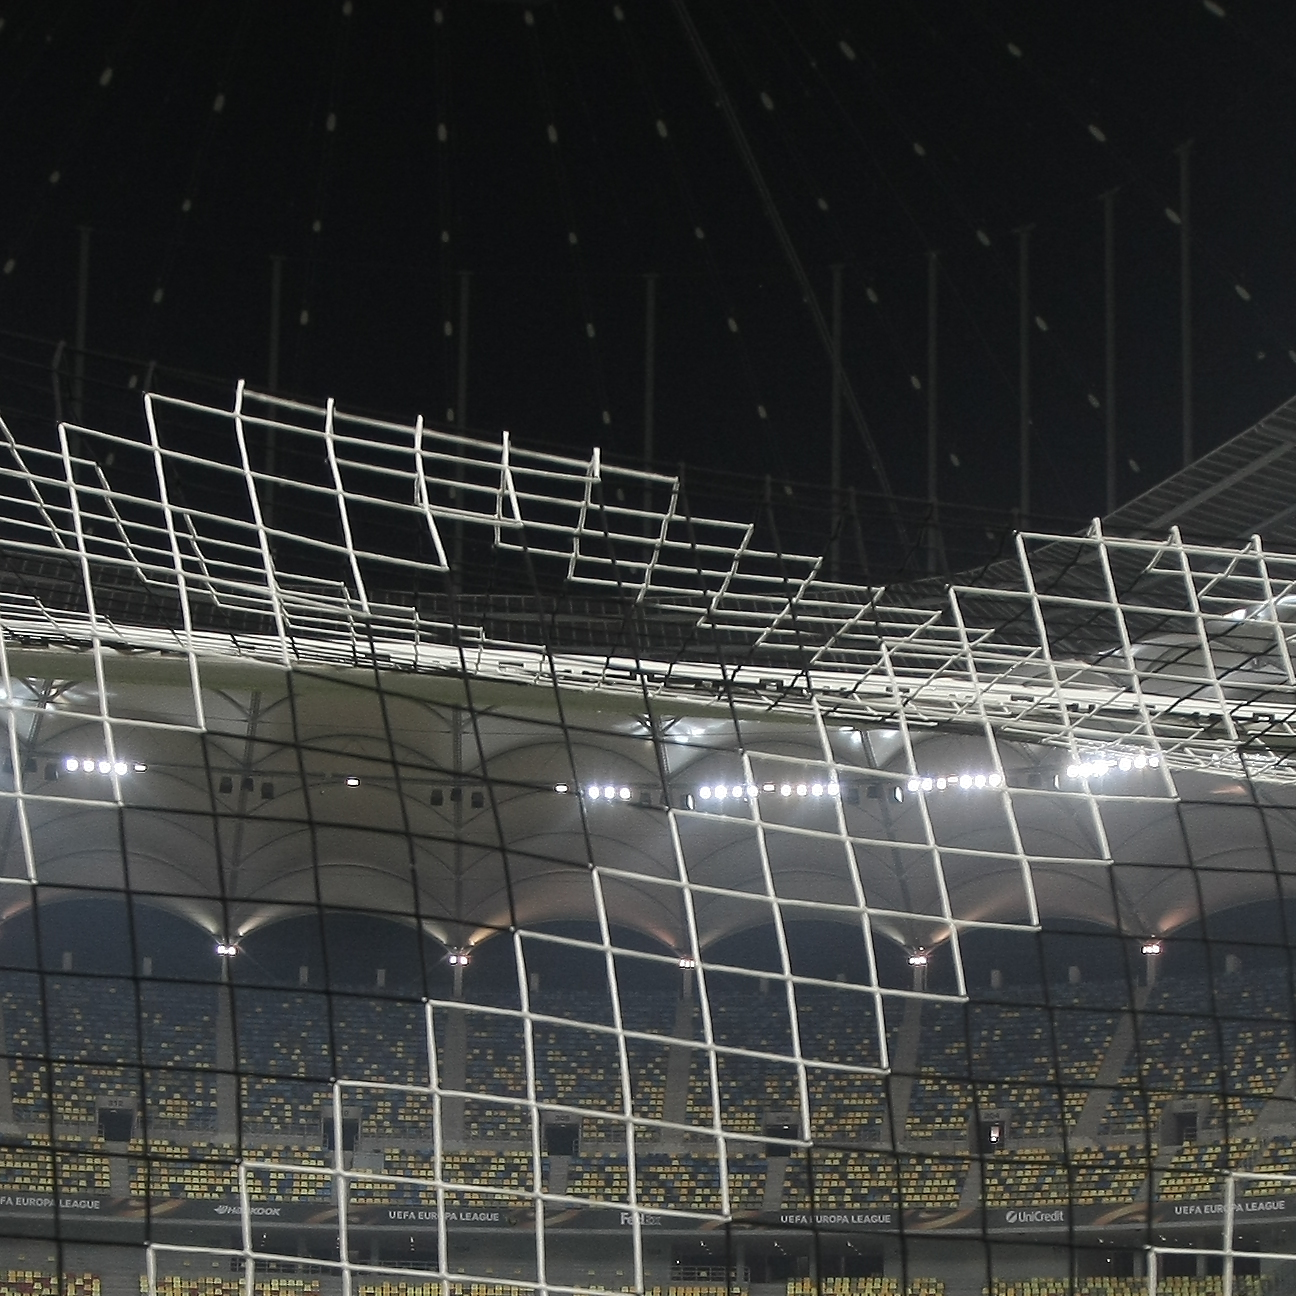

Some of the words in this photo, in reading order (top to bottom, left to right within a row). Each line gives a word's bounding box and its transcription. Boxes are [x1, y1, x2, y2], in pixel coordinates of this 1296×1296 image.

[59, 1199, 100, 1209] LEAGUE
[1174, 1206, 1202, 1215] UEFA
[1245, 1200, 1286, 1211] LEAGUE
[388, 1211, 416, 1220] UEFA
[418, 1211, 457, 1220] EURPA
[459, 1212, 499, 1221] LEAGUE
[780, 1215, 808, 1224] UEFA
[809, 1215, 849, 1224] UROPA
[851, 1214, 891, 1224] LEAGUE
[1018, 1211, 1064, 1222] UniCredit
